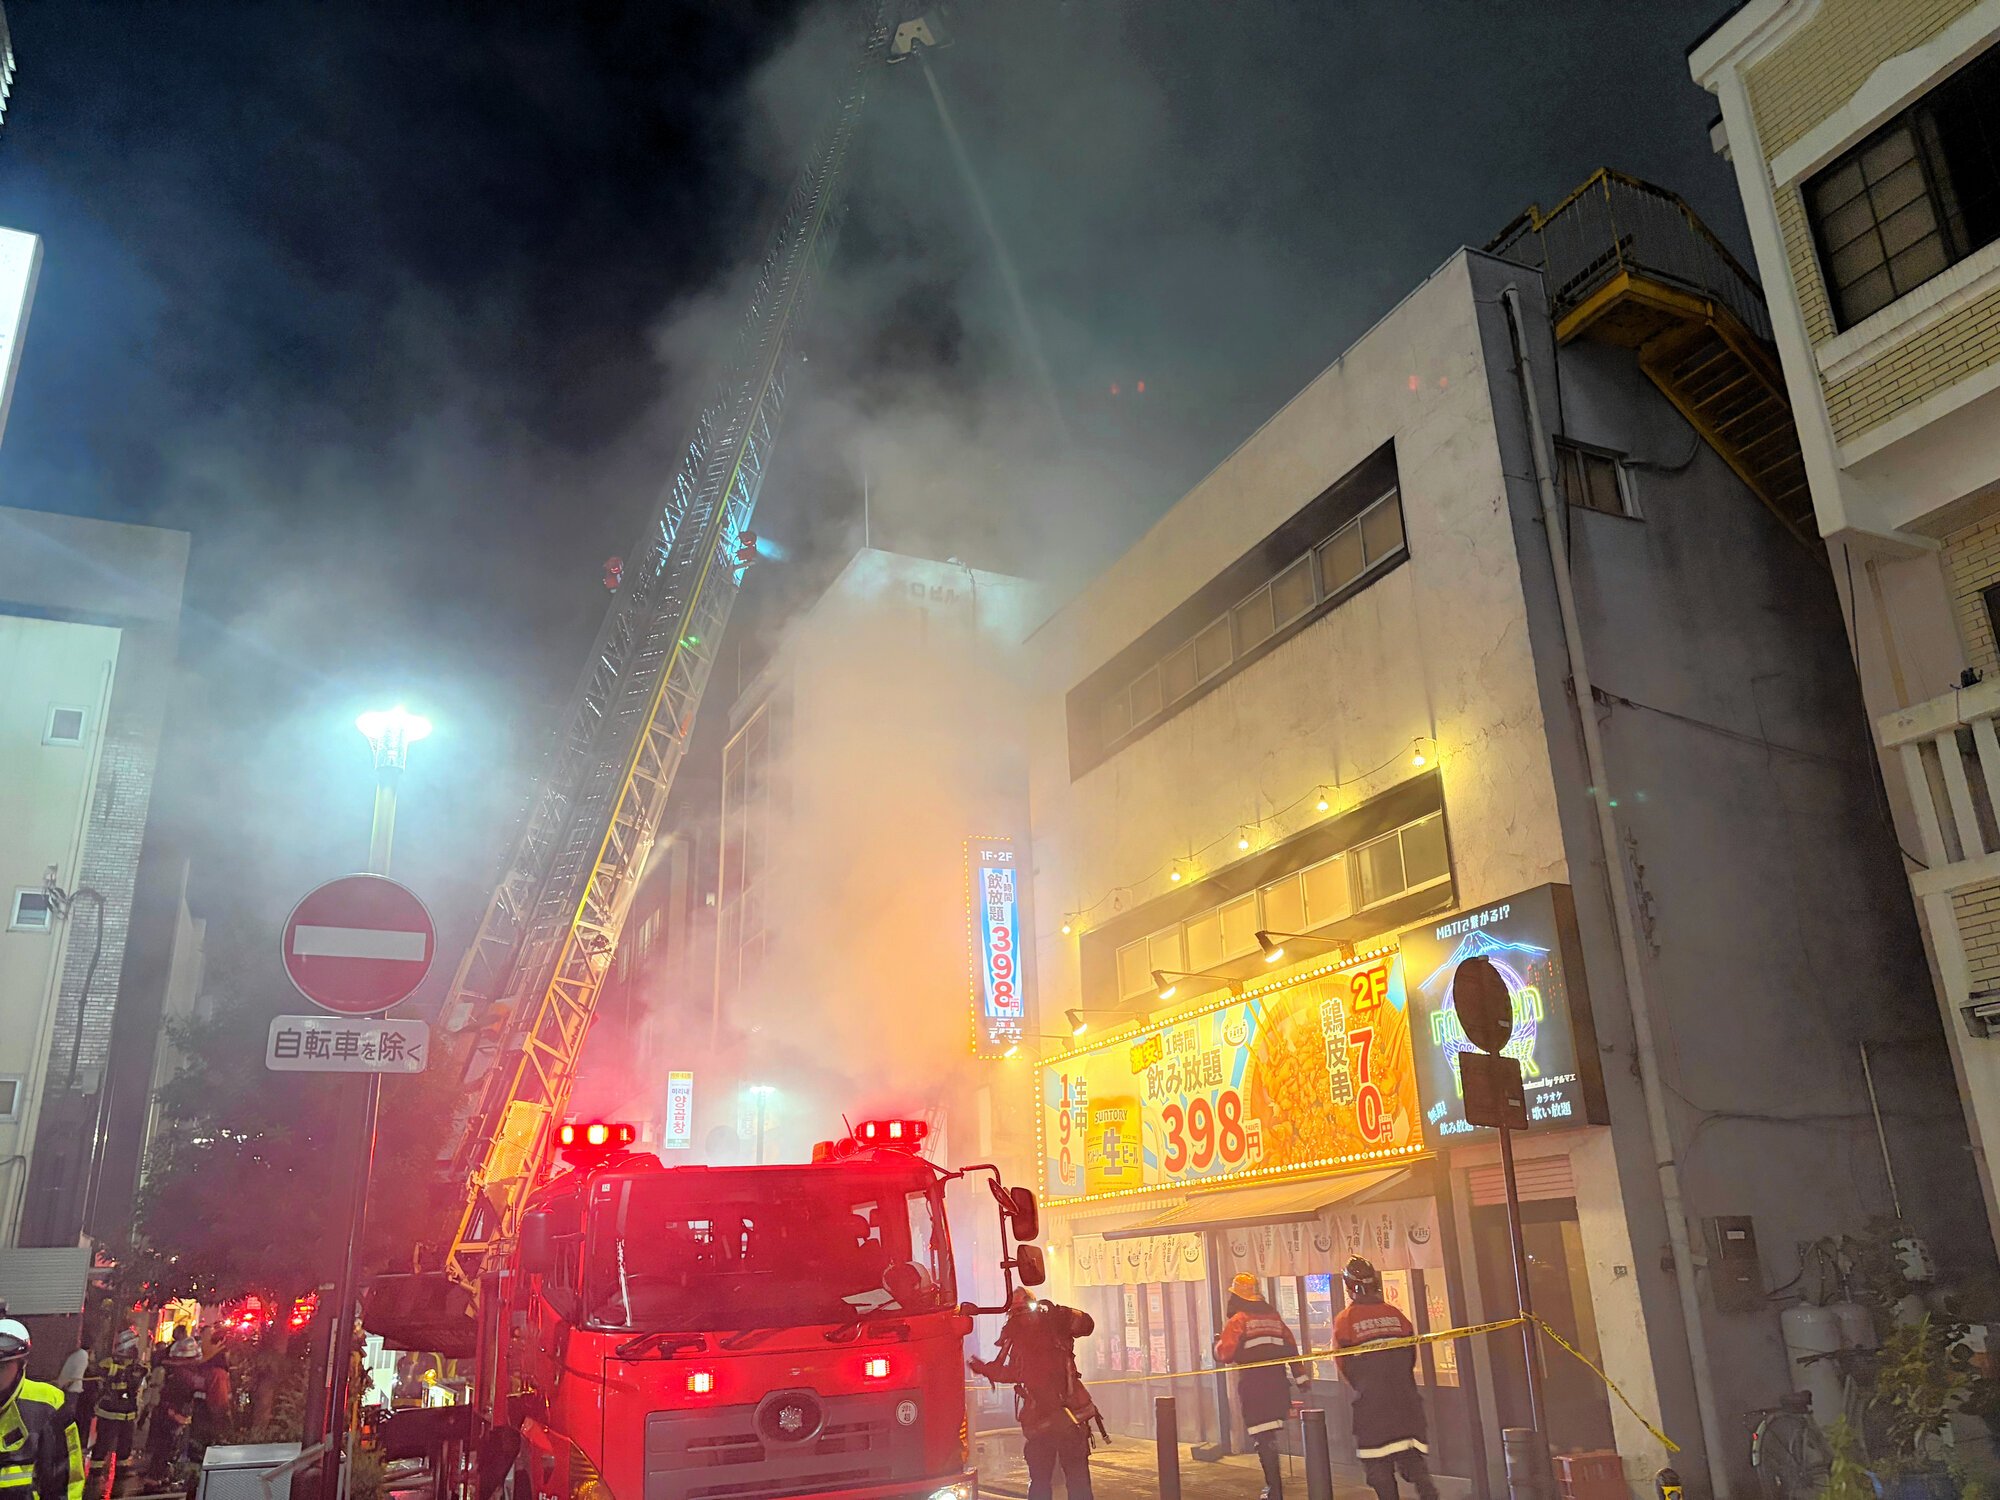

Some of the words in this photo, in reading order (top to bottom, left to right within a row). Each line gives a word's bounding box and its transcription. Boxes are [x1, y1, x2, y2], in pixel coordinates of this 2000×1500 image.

[988, 874, 1004, 922] 飲放題
[1004, 875, 1012, 902] 1時間
[1352, 967, 1387, 1012] 2F
[274, 1027, 421, 1061] 自転車を除く
[1166, 1029, 1196, 1055] 1時間
[1322, 1000, 1350, 1103] 鶏皮串
[1147, 1048, 1223, 1100] 飲み放題
[1074, 1076, 1088, 1137] 生中
[1427, 1101, 1447, 1125] 無限
[1532, 1101, 1572, 1120] 歌い放題
[1536, 1091, 1562, 1104] カラオケ
[1095, 1109, 1128, 1123] SUNTORY
[1103, 1128, 1122, 1175] 生
